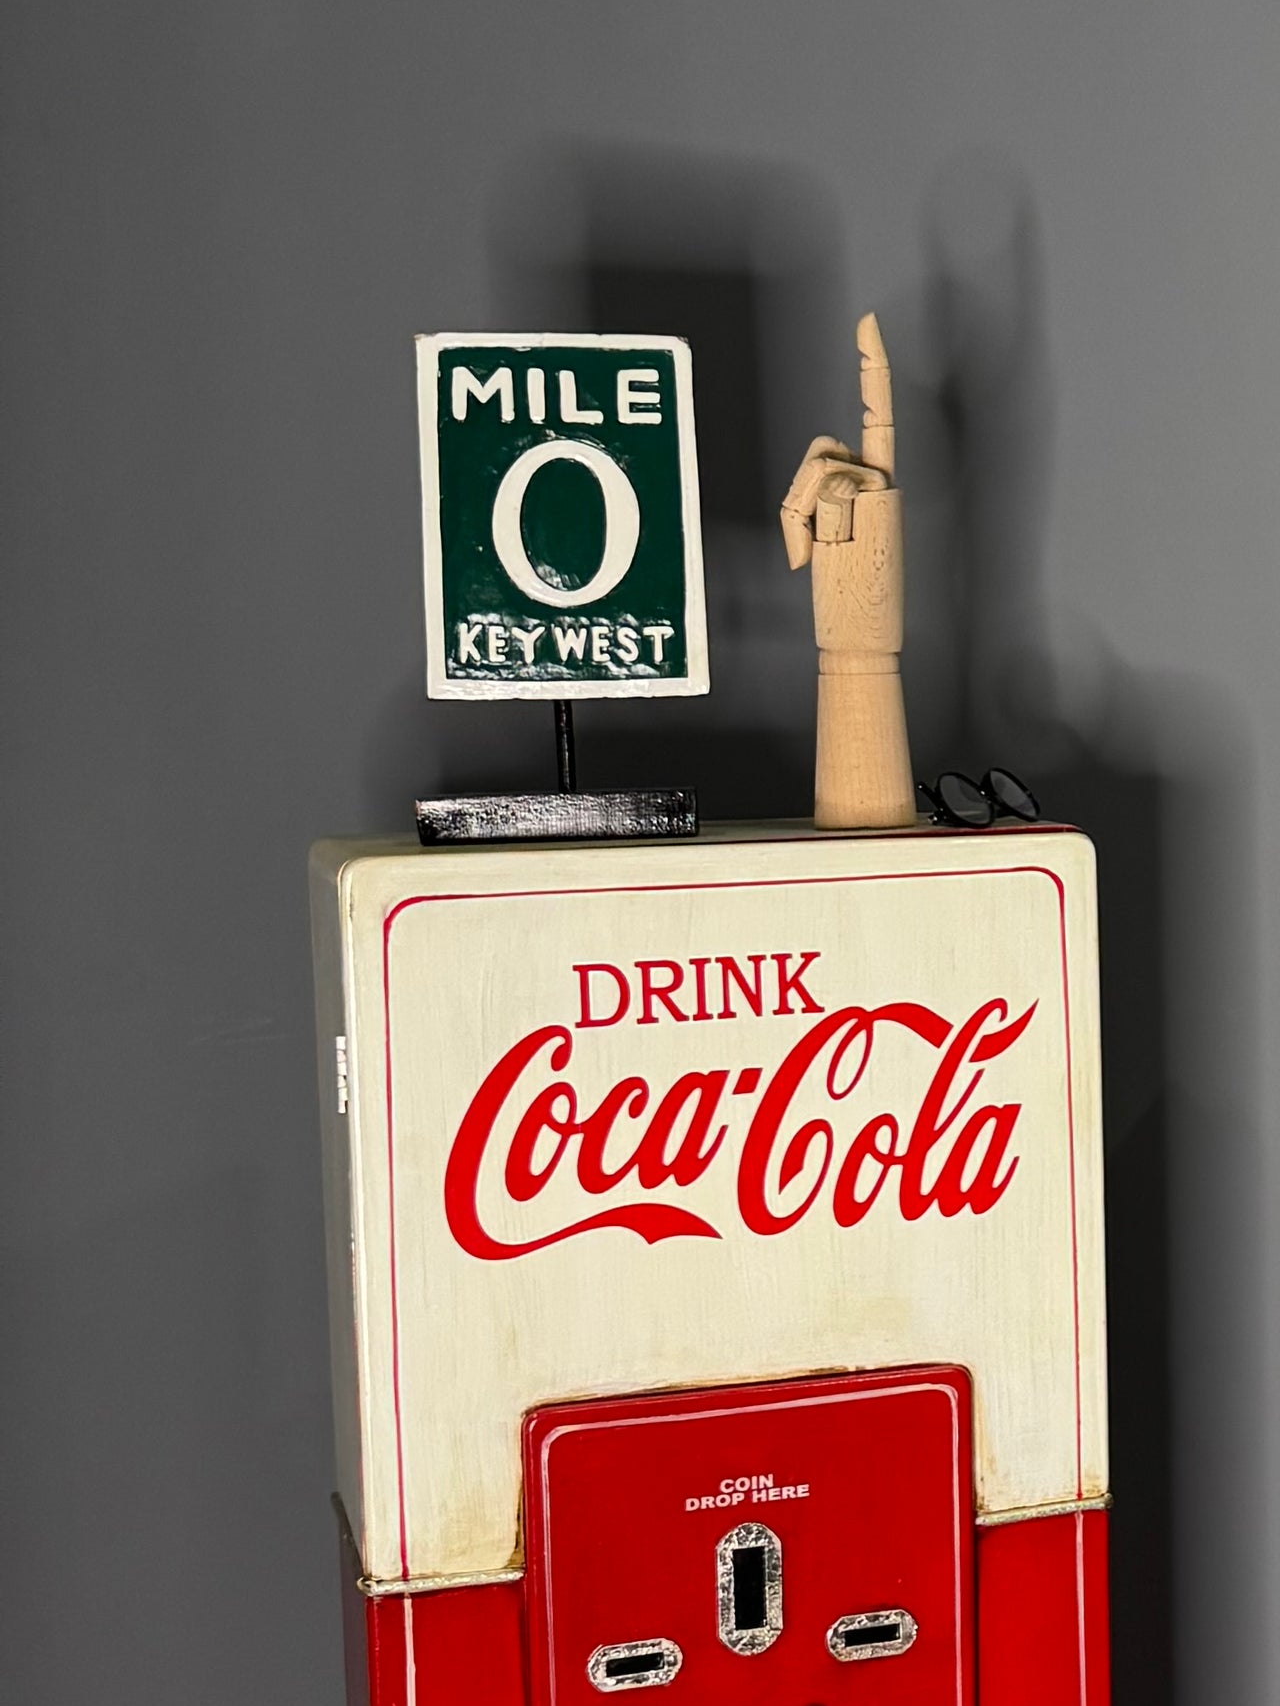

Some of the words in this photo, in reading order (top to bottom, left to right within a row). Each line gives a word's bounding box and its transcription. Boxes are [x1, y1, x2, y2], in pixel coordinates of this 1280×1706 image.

[451, 366, 664, 426] MILE
[458, 622, 545, 666] KEY
[552, 622, 676, 667] WEST
[572, 951, 825, 1029] DRINK
[444, 997, 1039, 1260] Coca-Cola
[684, 1490, 746, 1512] DROP
[751, 1482, 810, 1505] HERE
[718, 1473, 774, 1495] COIN
